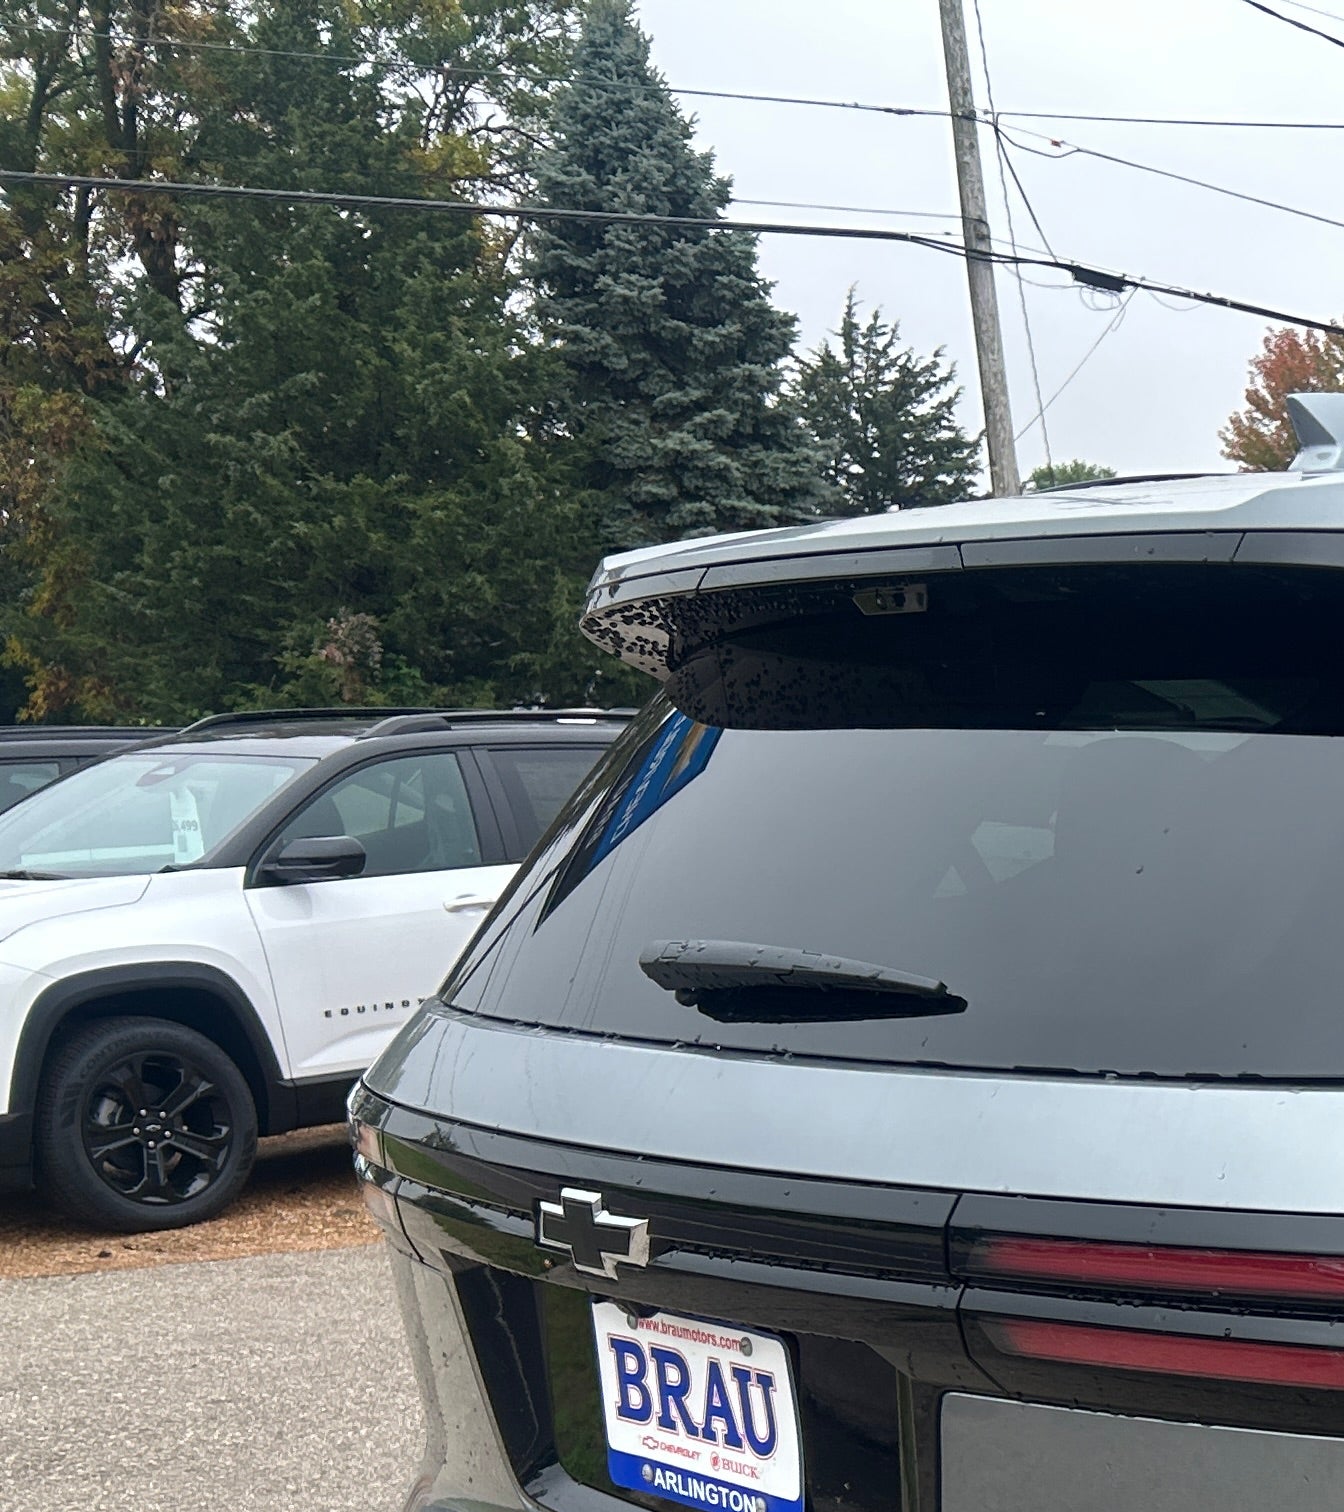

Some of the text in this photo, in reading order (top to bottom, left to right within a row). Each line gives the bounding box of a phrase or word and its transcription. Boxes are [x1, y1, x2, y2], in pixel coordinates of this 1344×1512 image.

[607, 1332, 778, 1461] BRAU
[660, 1442, 761, 1480] CHEVROLET BUICK
